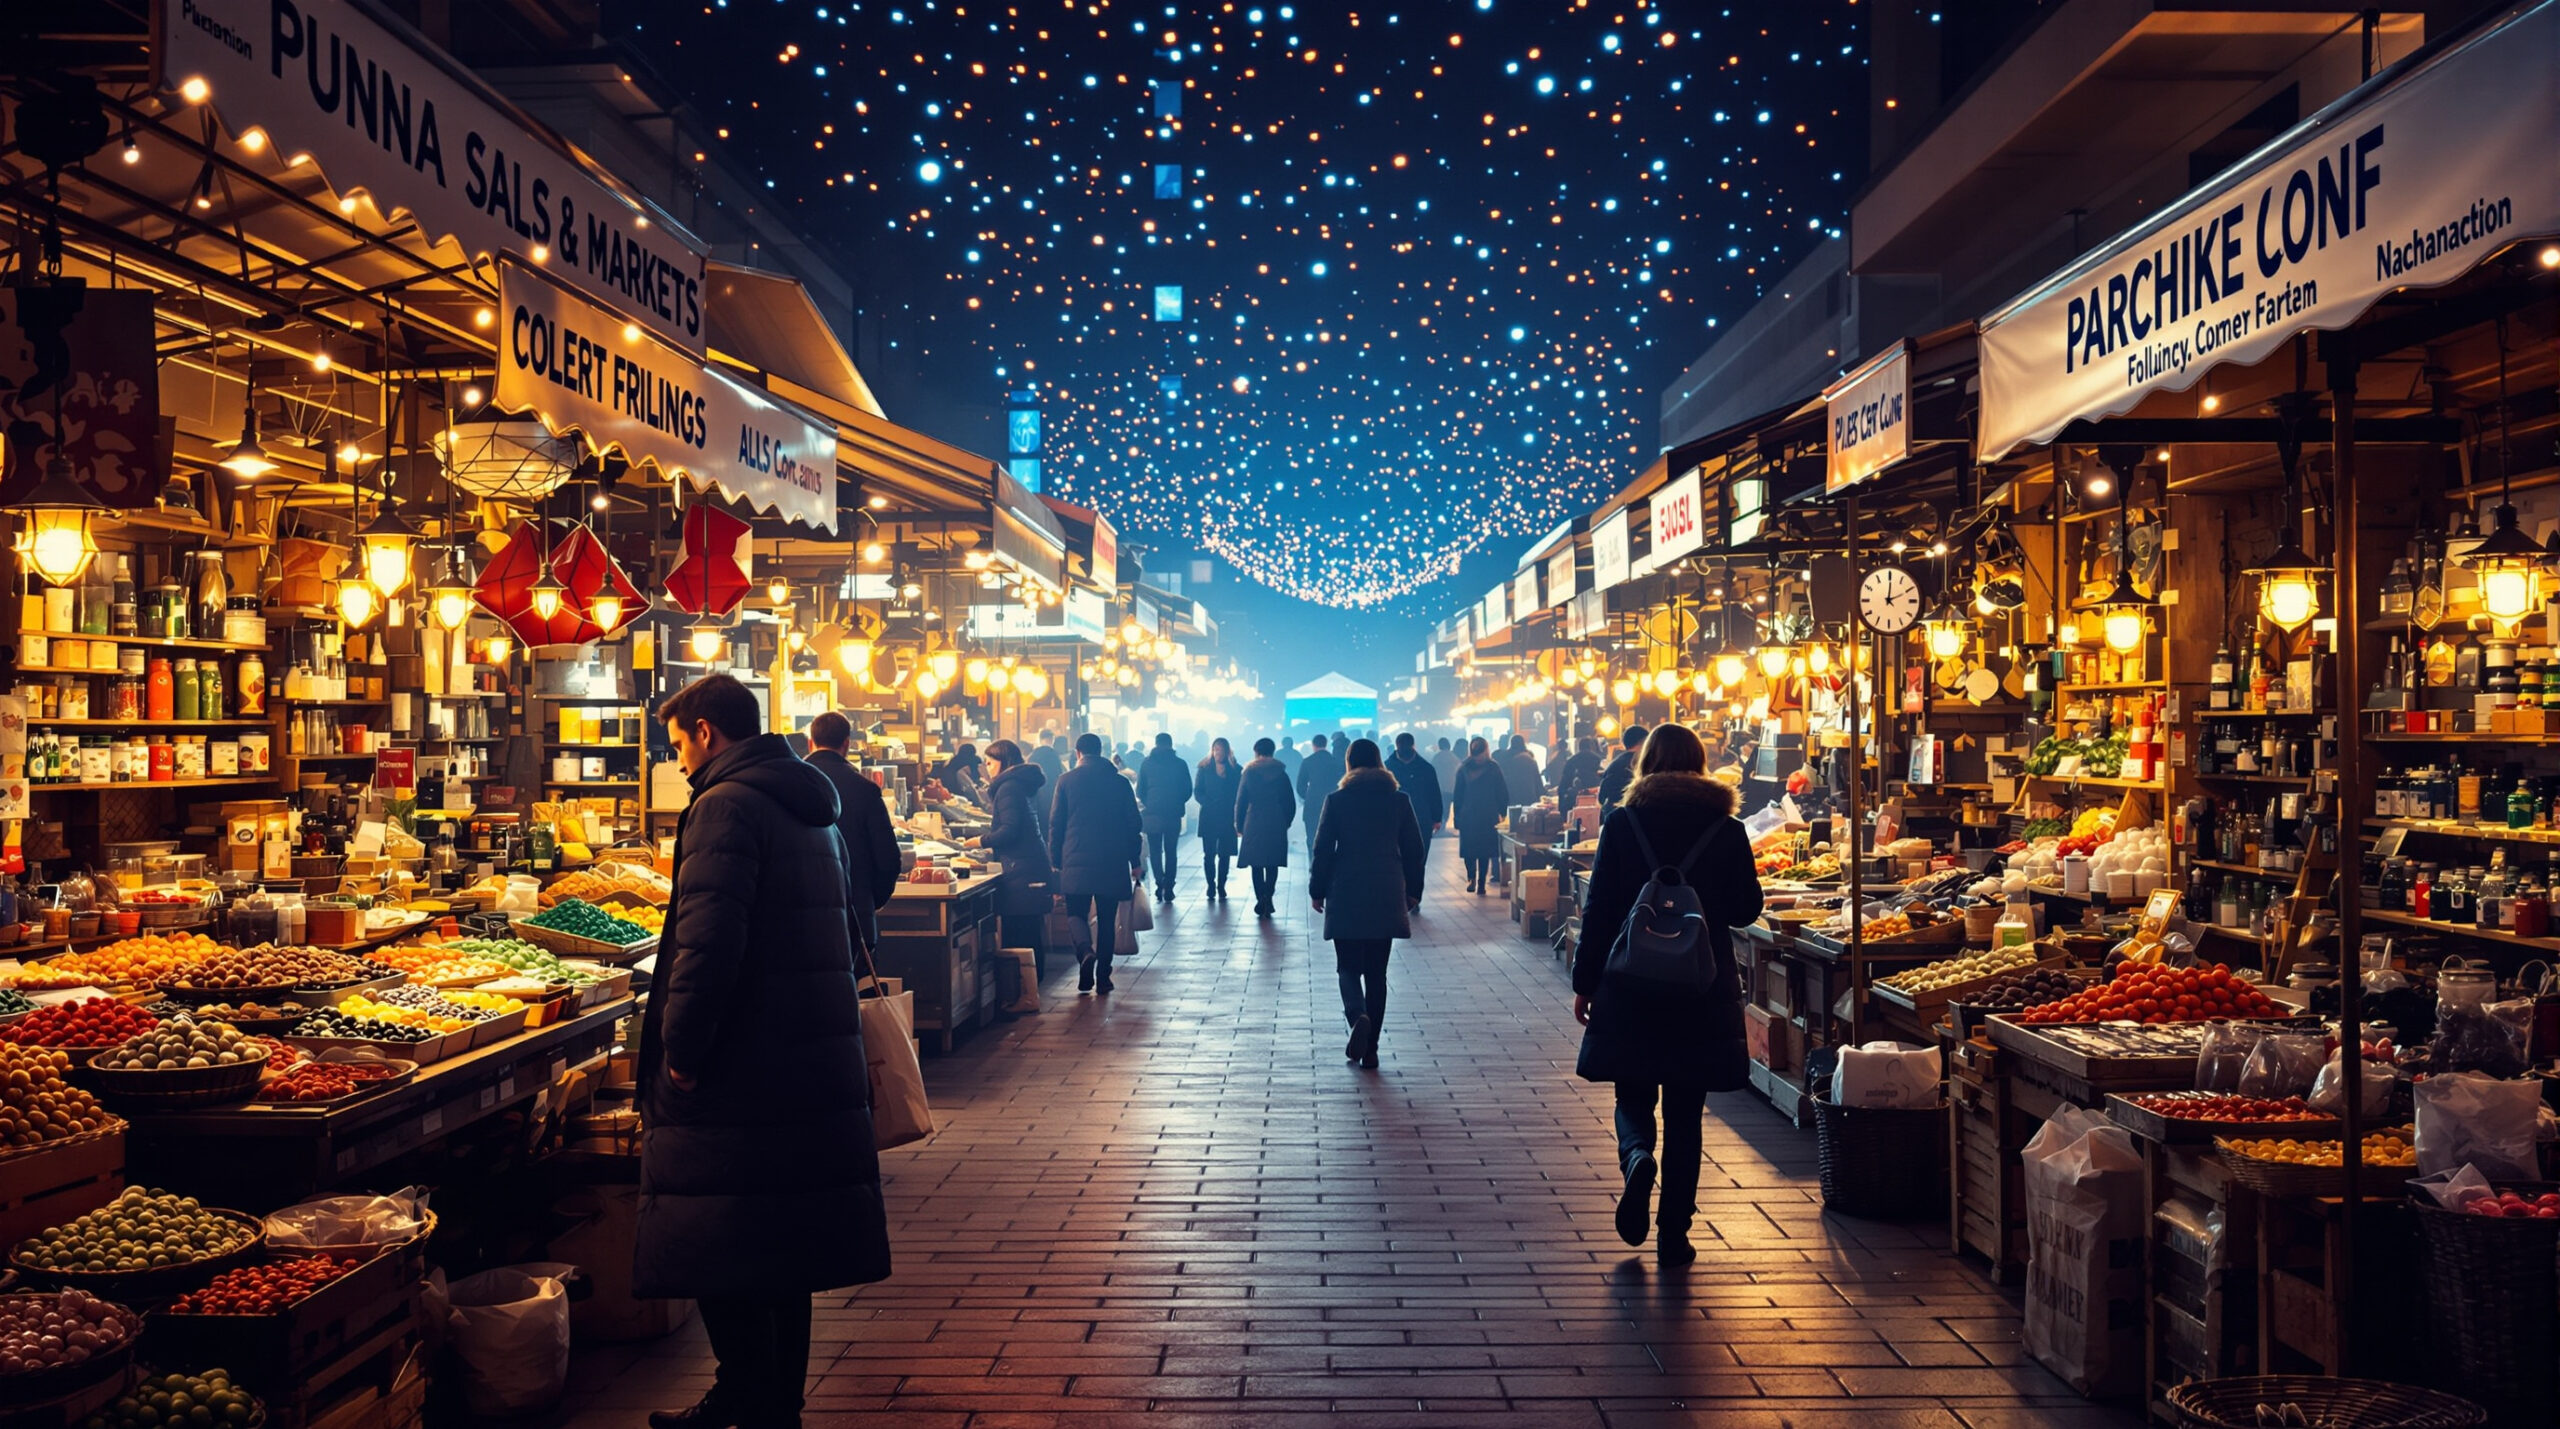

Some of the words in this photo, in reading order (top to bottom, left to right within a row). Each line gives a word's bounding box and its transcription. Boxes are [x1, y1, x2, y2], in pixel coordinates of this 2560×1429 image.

[271, 0, 447, 189] PUNNA
[465, 131, 551, 246] SALS
[559, 196, 578, 267] &
[588, 213, 700, 337] MARKETS
[2376, 196, 2512, 281] Nachanaction
[2066, 203, 2244, 374] PARCHIKE
[512, 305, 607, 403] COLERT
[613, 357, 706, 449] FRILINGS
[738, 423, 771, 474] ALLS
